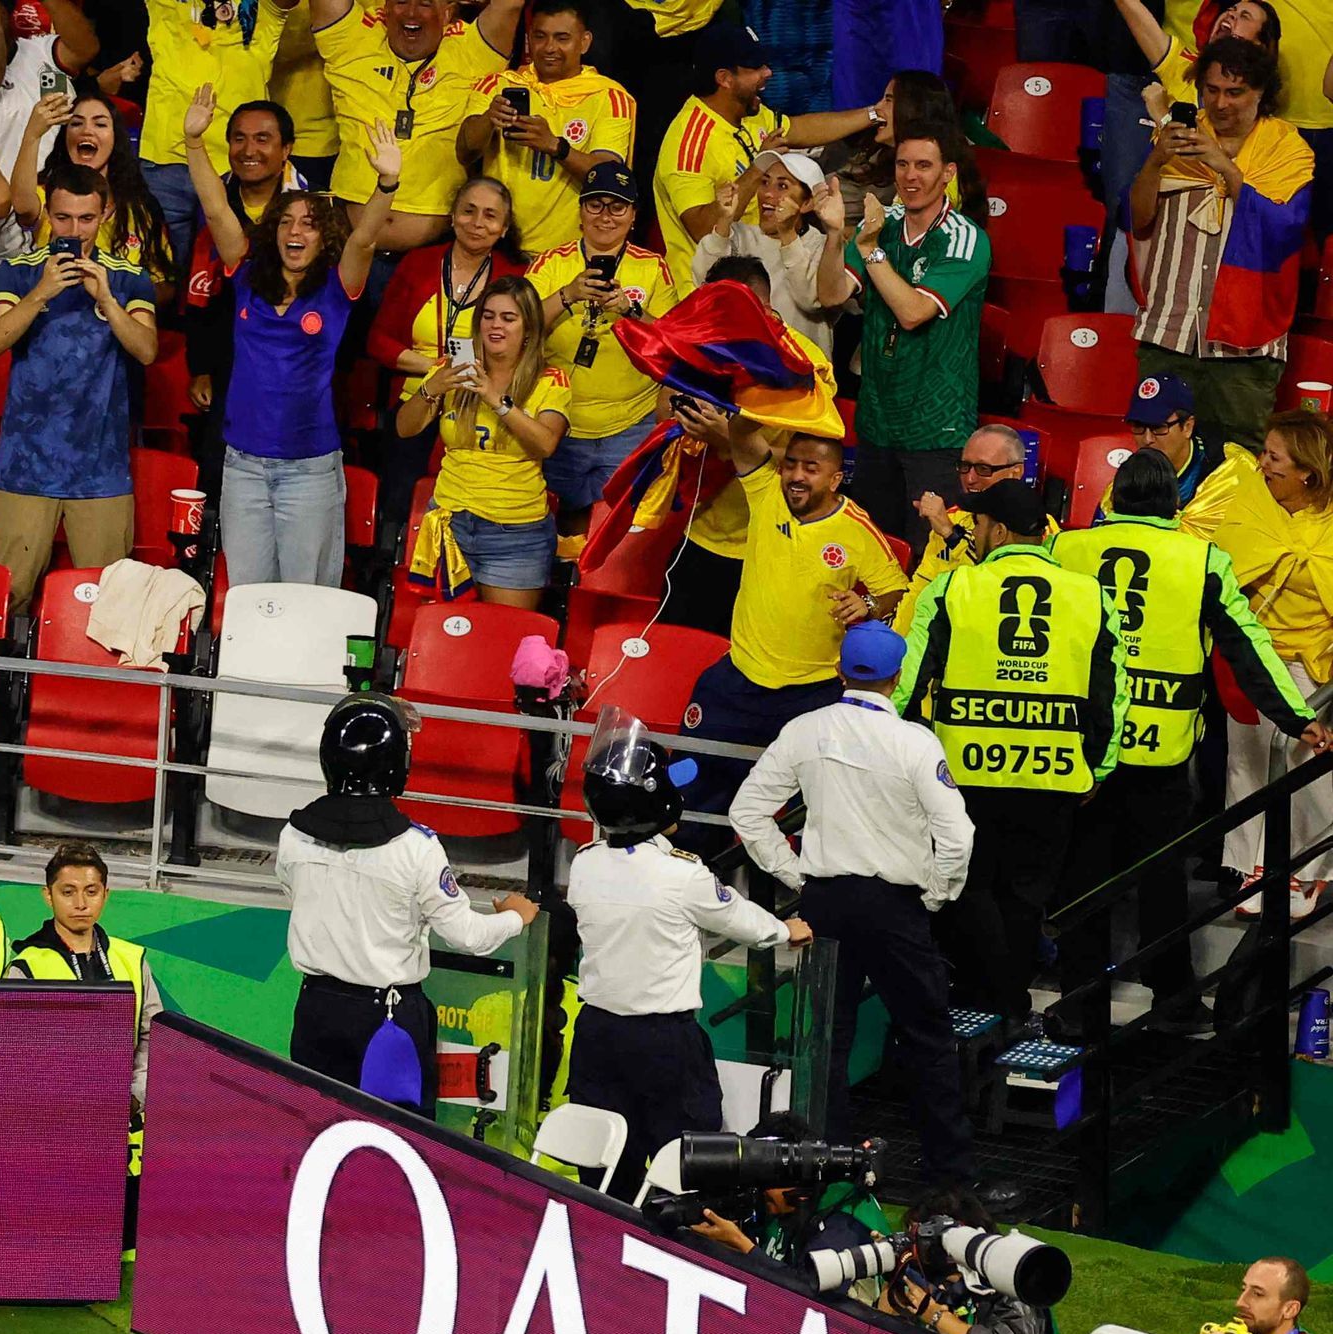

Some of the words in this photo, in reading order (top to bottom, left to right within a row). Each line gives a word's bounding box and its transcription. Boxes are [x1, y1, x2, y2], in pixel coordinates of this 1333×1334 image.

[1012, 640, 1037, 650] FIFA
[1124, 635, 1142, 643] CUP
[997, 659, 1030, 668] WORLD
[1031, 660, 1049, 669] CUP
[996, 669, 1049, 682] 2026
[1124, 674, 1182, 704] RITY
[950, 696, 1079, 726] SECURIT
[962, 742, 1075, 776] 09755
